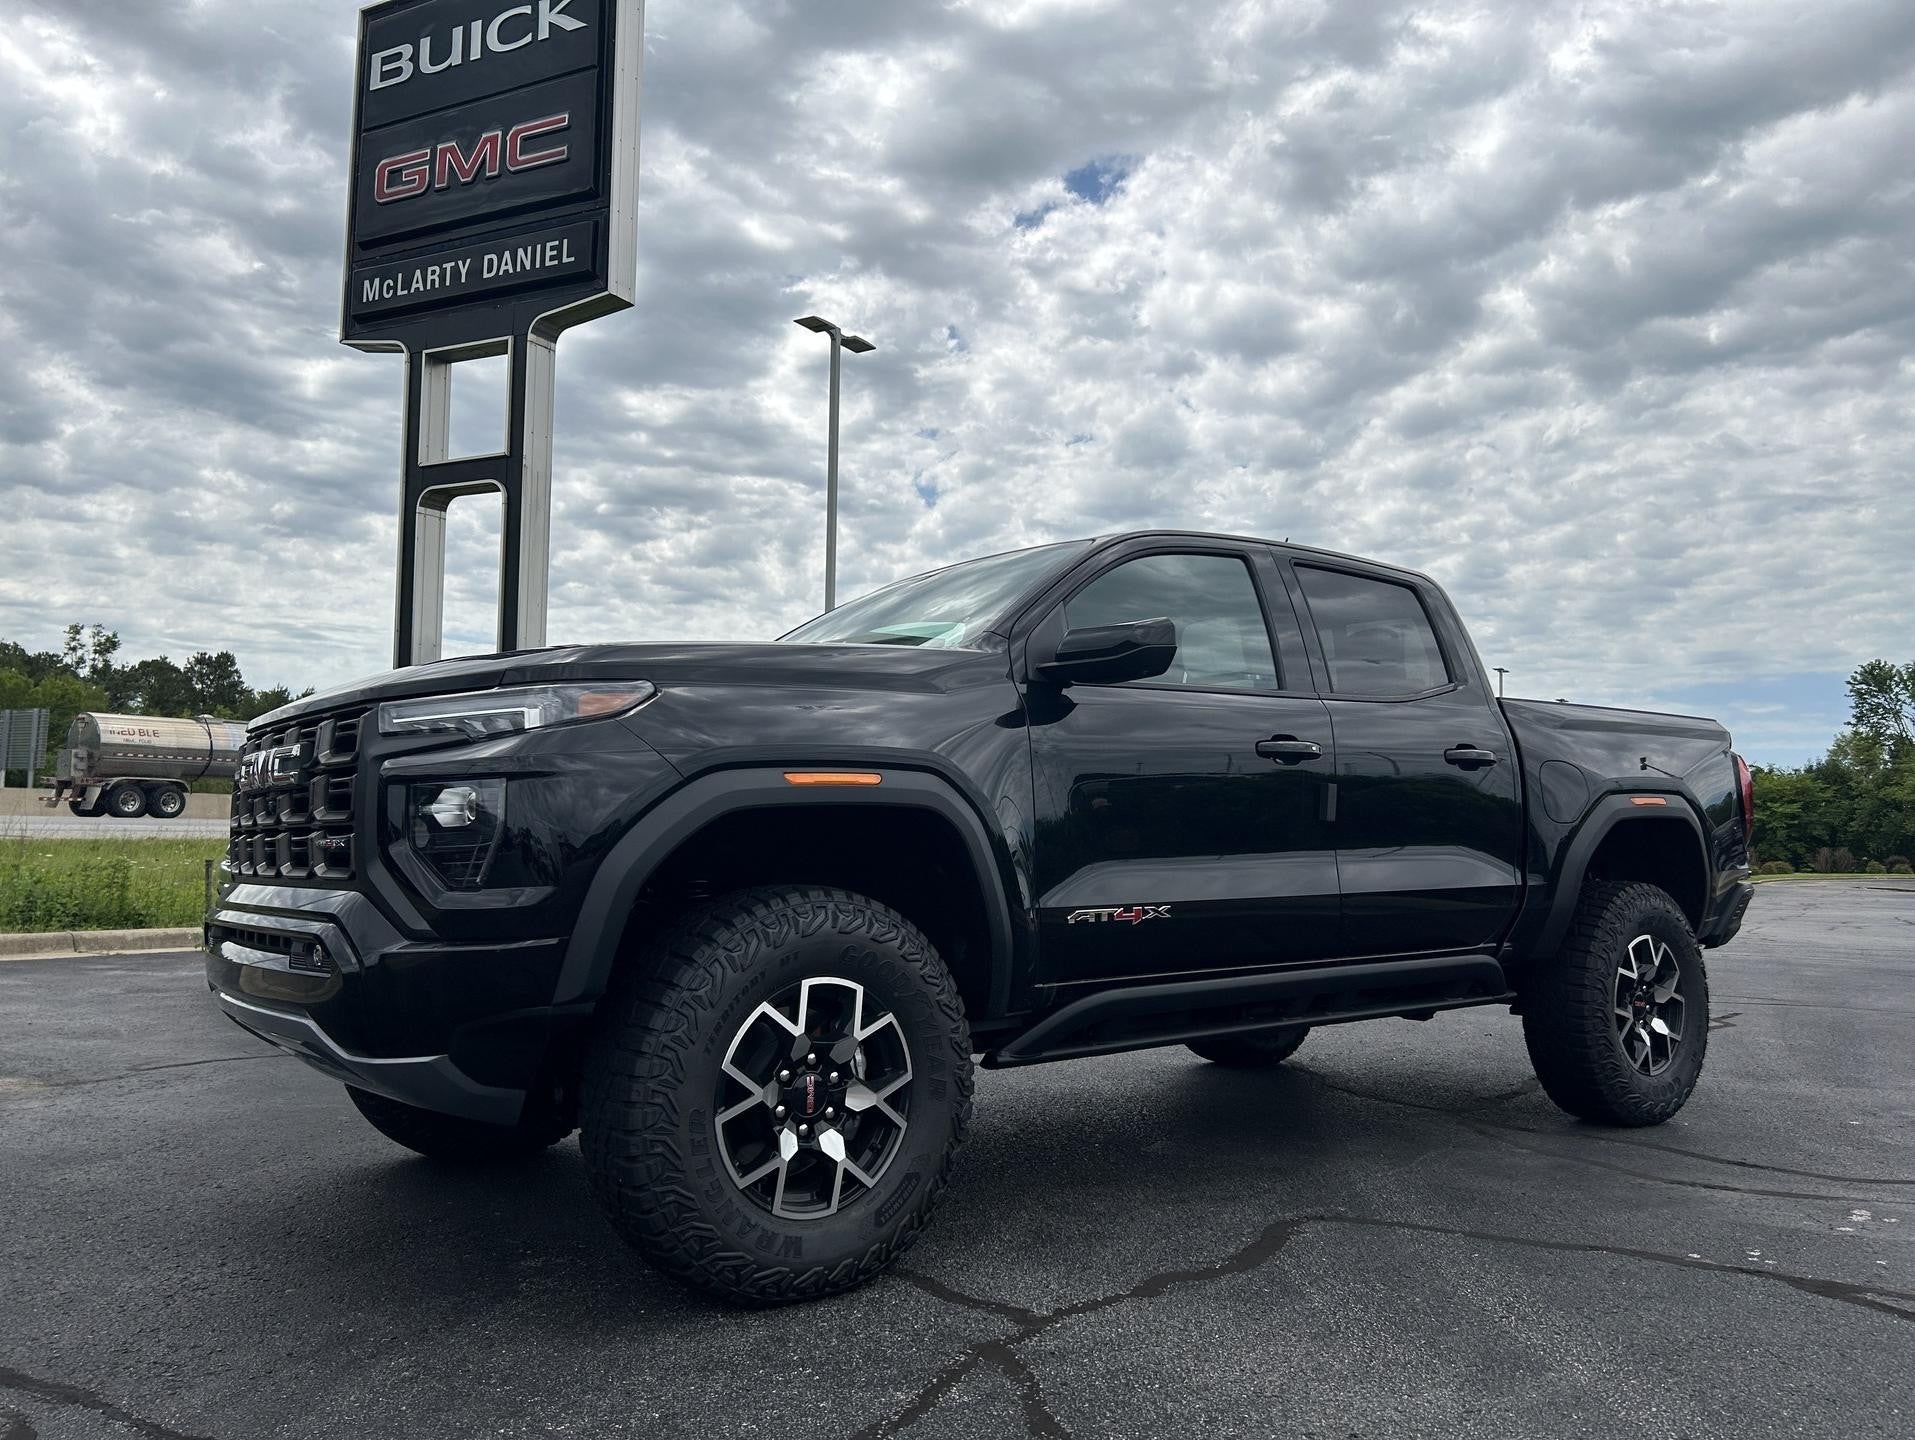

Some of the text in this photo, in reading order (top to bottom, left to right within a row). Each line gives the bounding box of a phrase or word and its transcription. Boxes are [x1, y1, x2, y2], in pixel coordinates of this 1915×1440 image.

[369, 0, 588, 91] BUICK
[374, 111, 570, 204] GMC
[362, 238, 576, 303] McLARTY DANIEL
[1067, 905, 1172, 926] AT4X
[806, 1075, 816, 1114] GMC
